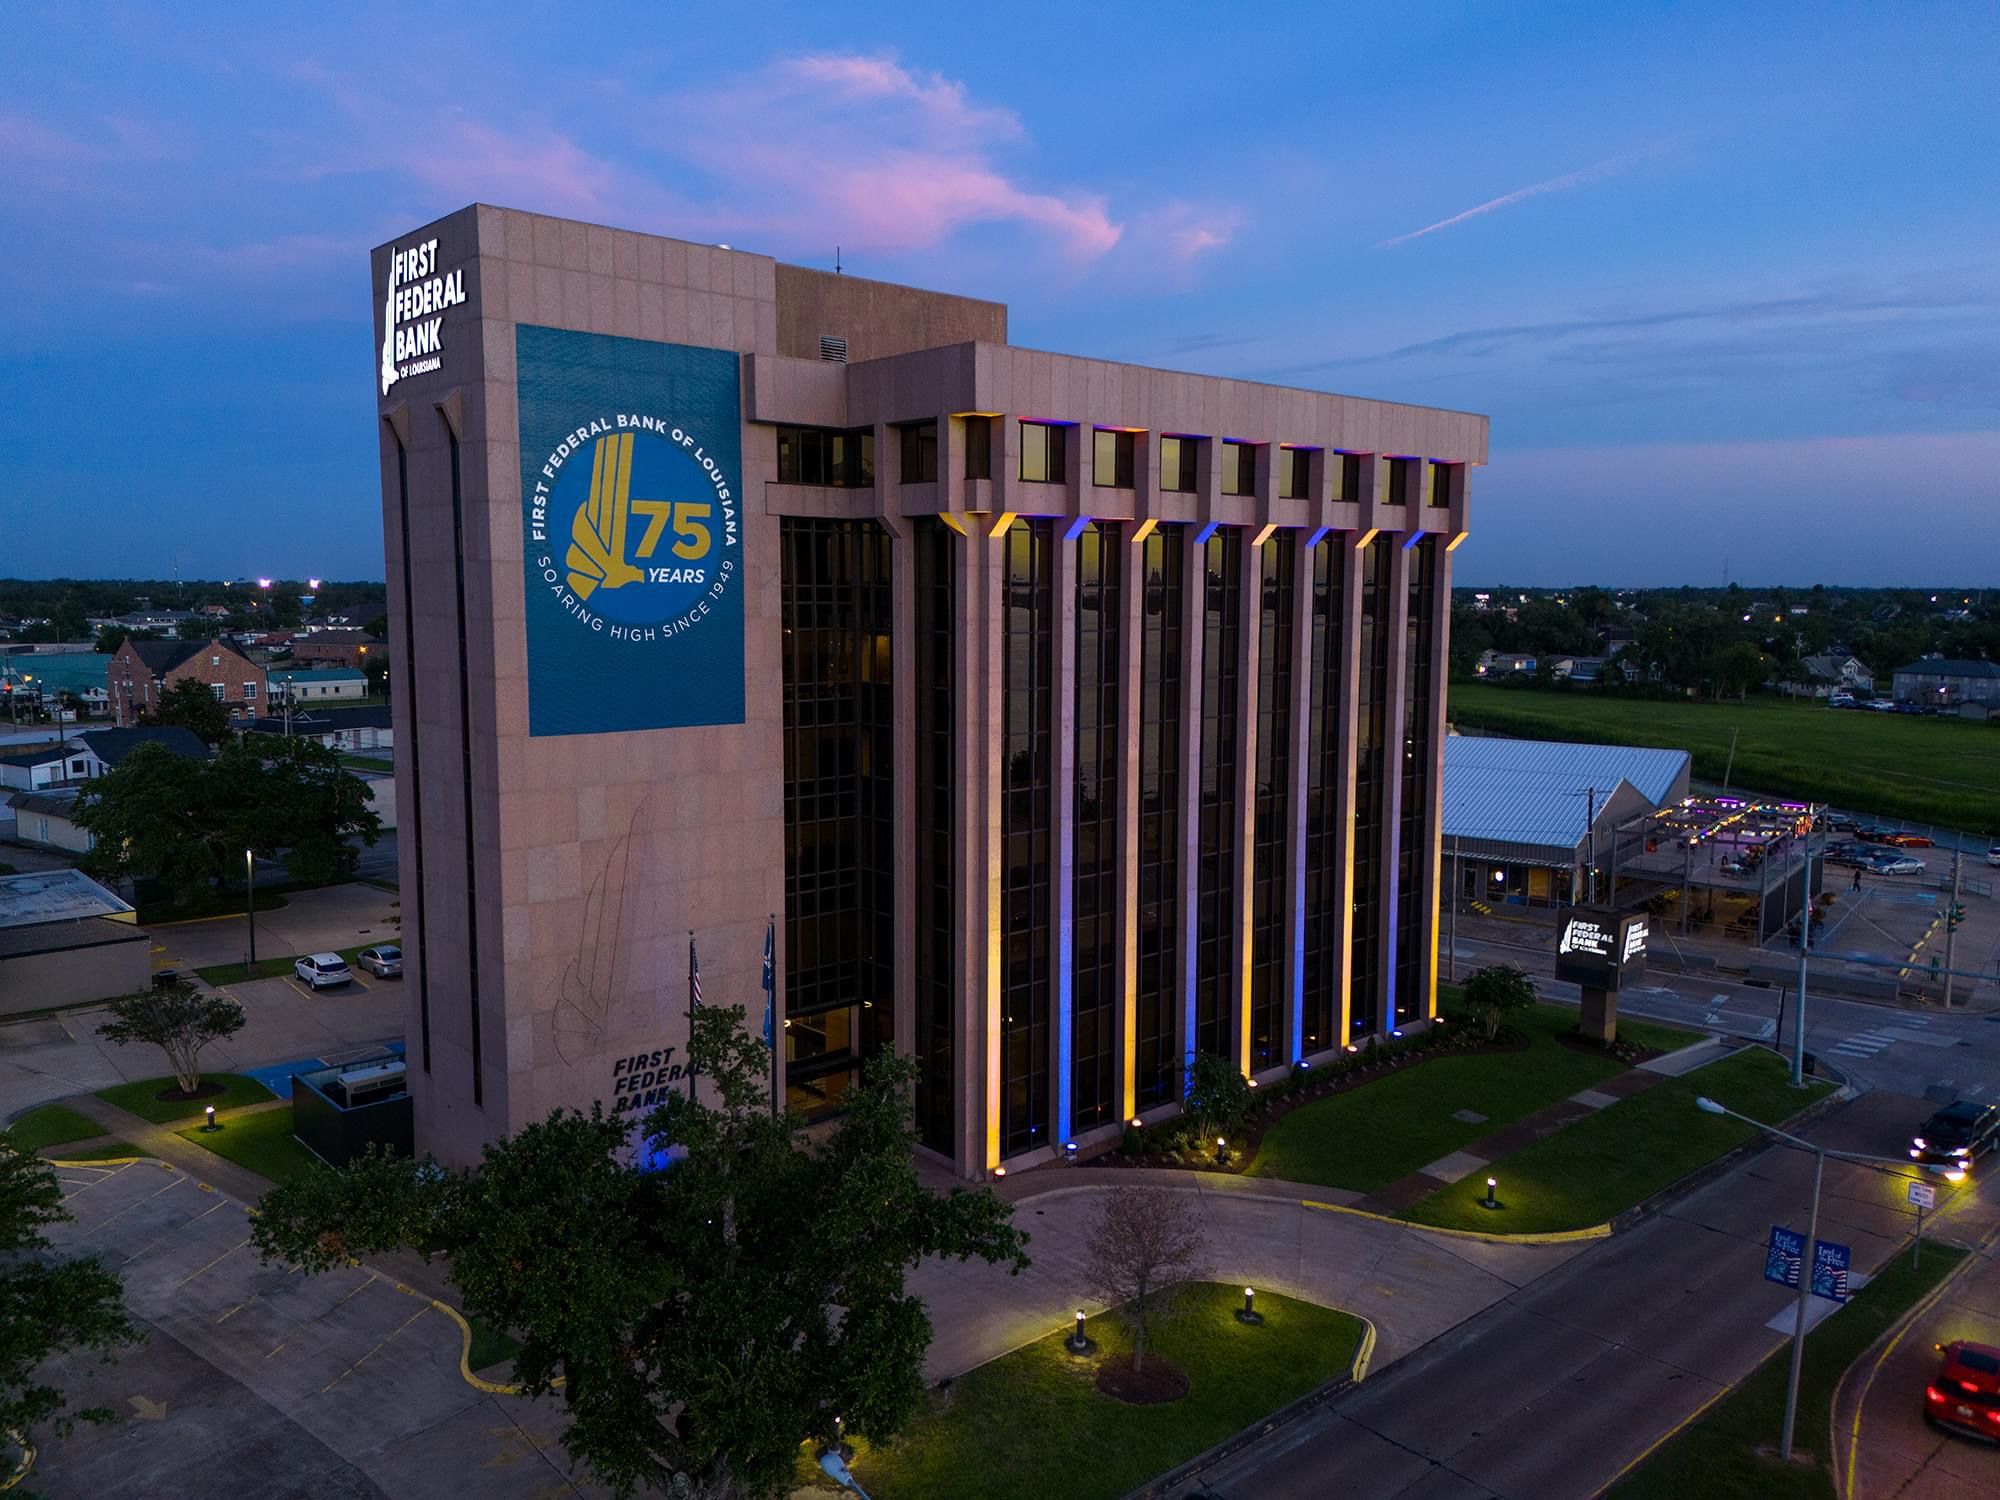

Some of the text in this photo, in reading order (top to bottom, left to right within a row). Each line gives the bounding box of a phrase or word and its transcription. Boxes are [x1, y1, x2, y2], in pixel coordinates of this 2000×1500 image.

[396, 238, 438, 286] FIRST
[395, 269, 466, 324] FEDERAL
[396, 317, 442, 362] BANK
[400, 356, 441, 378] OF LOUISIANA
[532, 414, 737, 546] FIRST FEDERAL BANK OF LOUISIANA
[631, 499, 711, 560] 75
[648, 567, 705, 583] YEARS
[538, 556, 734, 641] SOARING HIGH SINCE 1949
[1572, 929, 1614, 943] FEDERAL
[1573, 921, 1600, 932] FIRST
[1572, 937, 1598, 948] BANK
[613, 1047, 675, 1077] FIRST
[1782, 1241, 1799, 1254] Free
[1818, 1246, 1835, 1256] Land
[1827, 1255, 1845, 1267] Free
